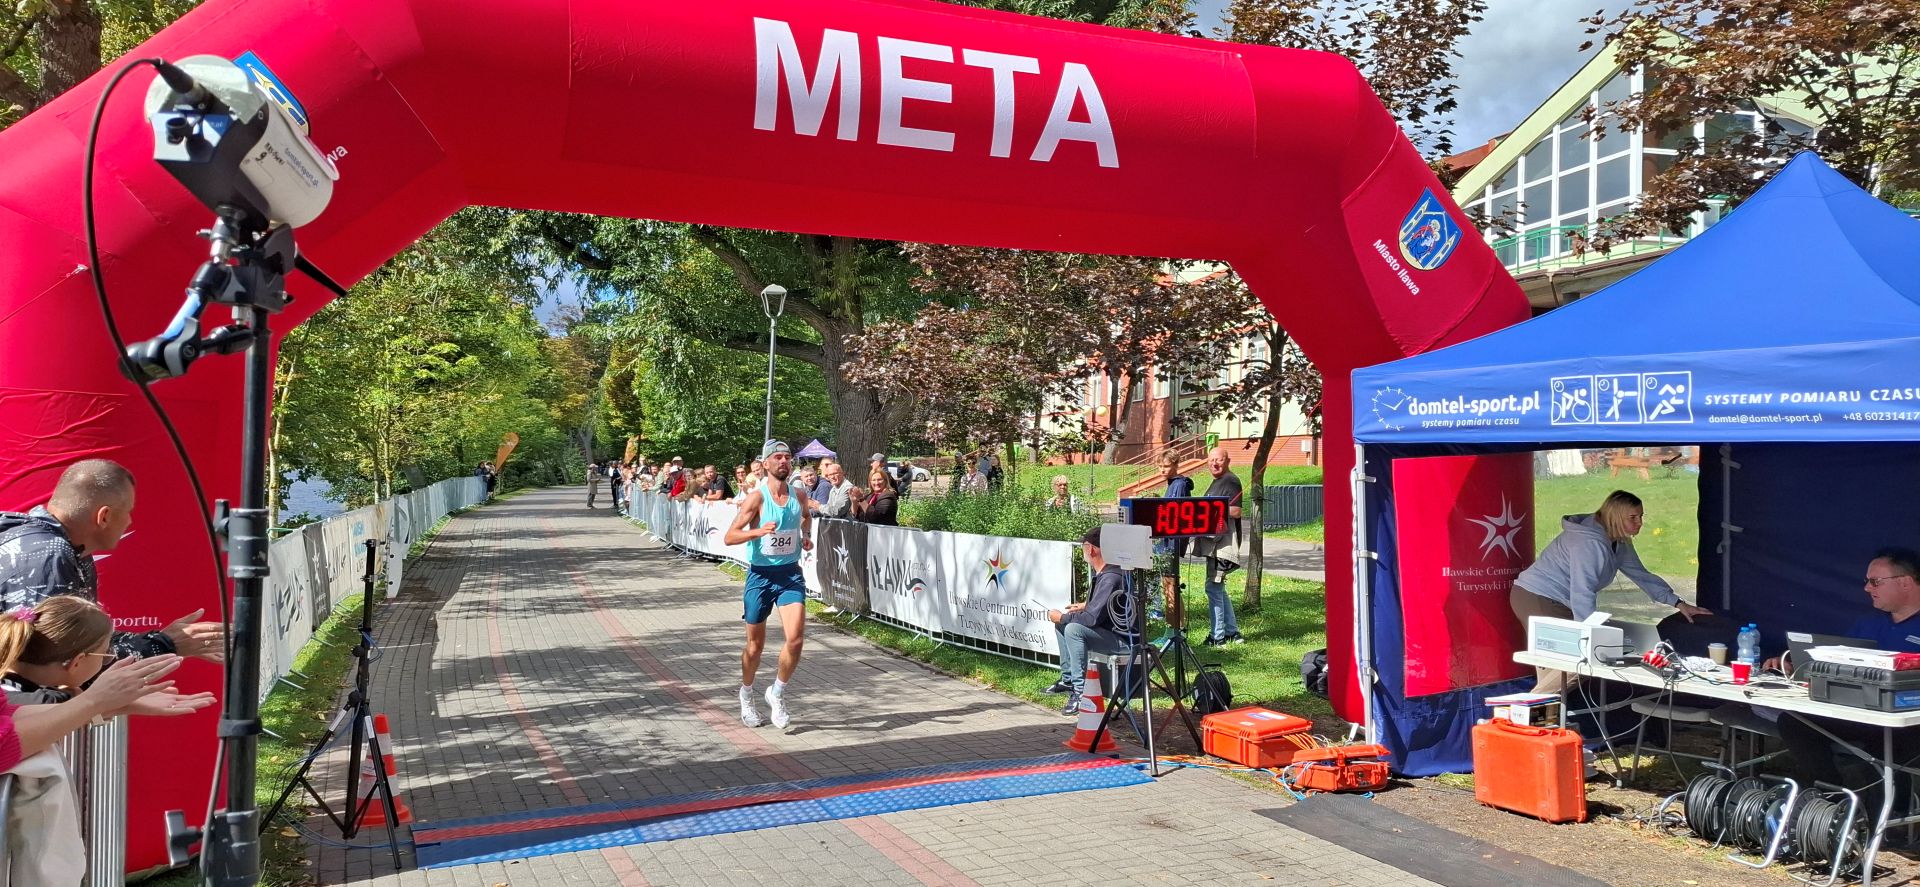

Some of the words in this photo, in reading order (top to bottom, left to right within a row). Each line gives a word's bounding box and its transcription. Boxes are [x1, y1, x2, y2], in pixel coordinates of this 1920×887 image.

[753, 16, 1120, 168] META
[1372, 239, 1400, 271] Miasto
[1408, 390, 1540, 417] domtel-sport.pl
[1704, 393, 1773, 405] SYSTEMY
[1779, 390, 1861, 404] POMIARU
[1421, 419, 1454, 429] systemy
[1456, 417, 1492, 428] pomiaru
[1494, 417, 1520, 426] czasu
[1708, 413, 1823, 424] domtel@domtel-sport.pl
[1842, 411, 1863, 421] +48
[770, 536, 792, 547] 284
[1456, 581, 1501, 594] Turystyki
[979, 597, 1018, 617] Centrum
[108, 613, 163, 631] portu,
[1000, 623, 1047, 648] Rekreacji
